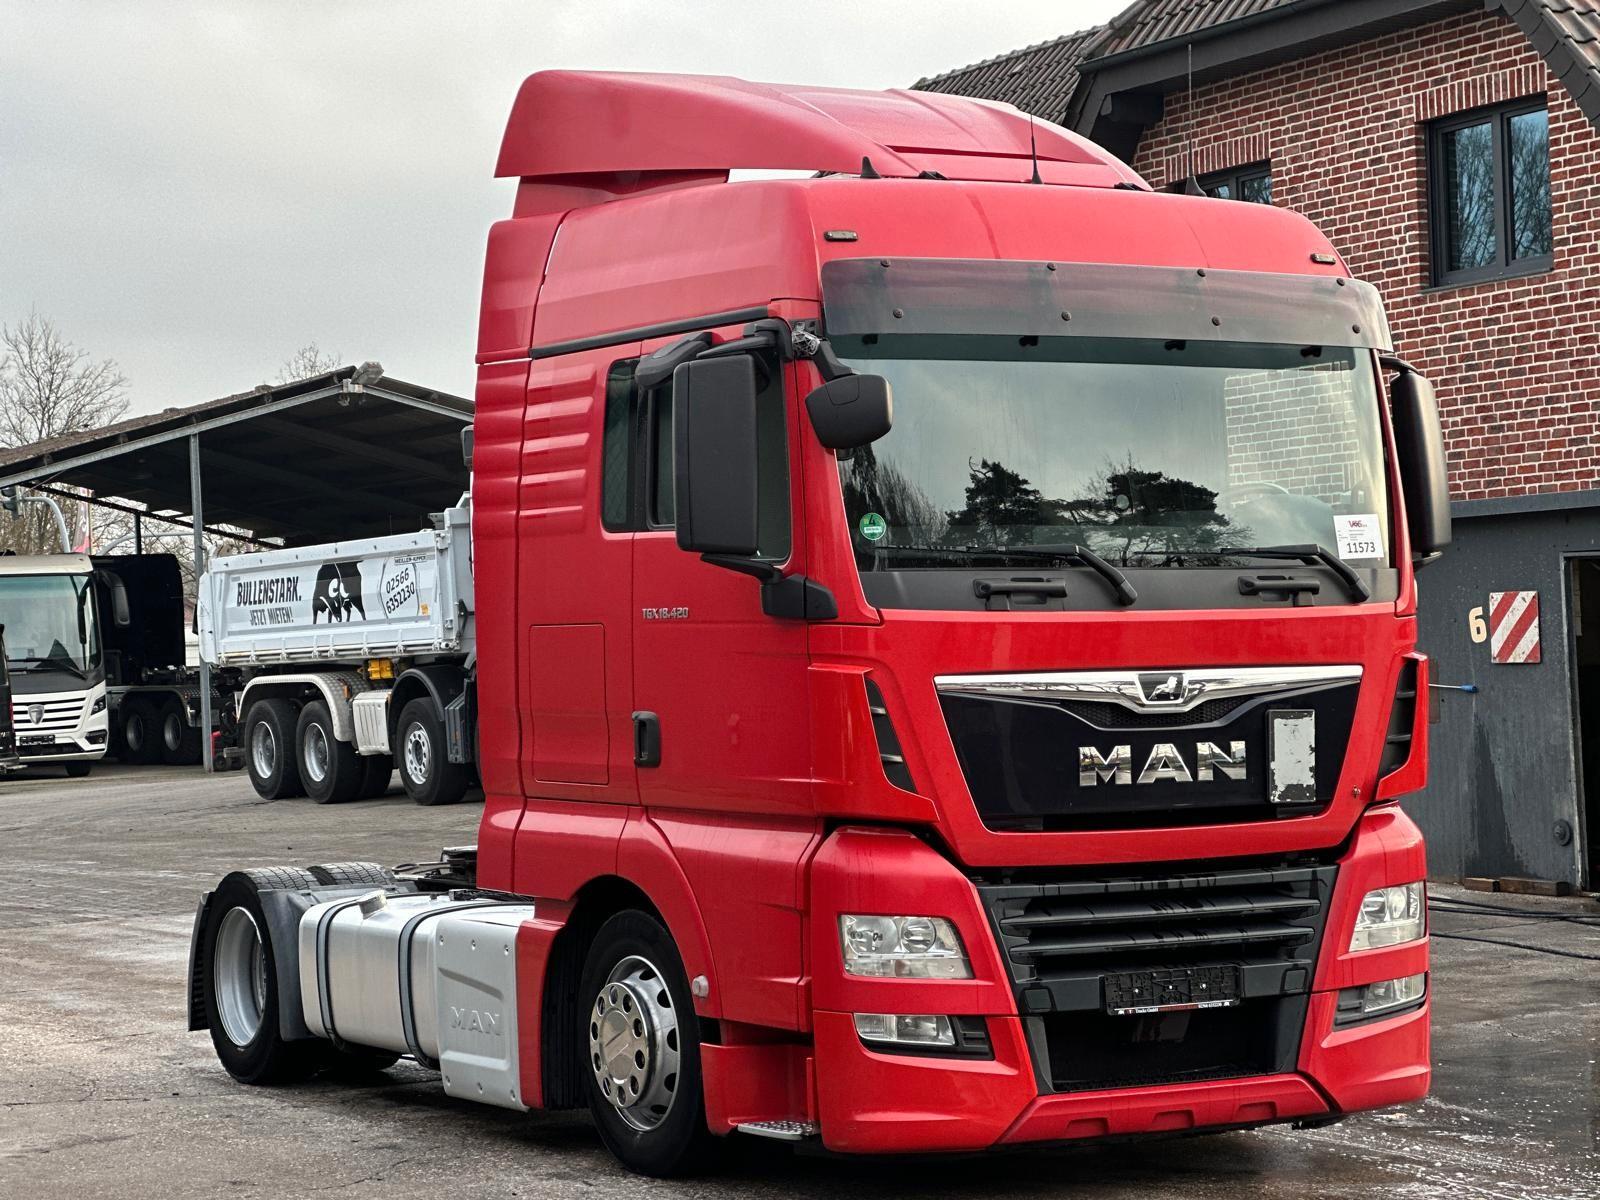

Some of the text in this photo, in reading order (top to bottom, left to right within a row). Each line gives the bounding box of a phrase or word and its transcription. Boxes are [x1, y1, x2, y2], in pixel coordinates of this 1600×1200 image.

[1346, 542, 1376, 553] 11573
[237, 576, 302, 607] BULLENSTARK.
[386, 567, 410, 594] 02566
[385, 581, 416, 614] 6352230
[249, 606, 294, 626] JETZT MIETEN!
[1468, 606, 1488, 644] 6
[1078, 741, 1247, 787] MAN
[450, 1006, 502, 1036] MAN
